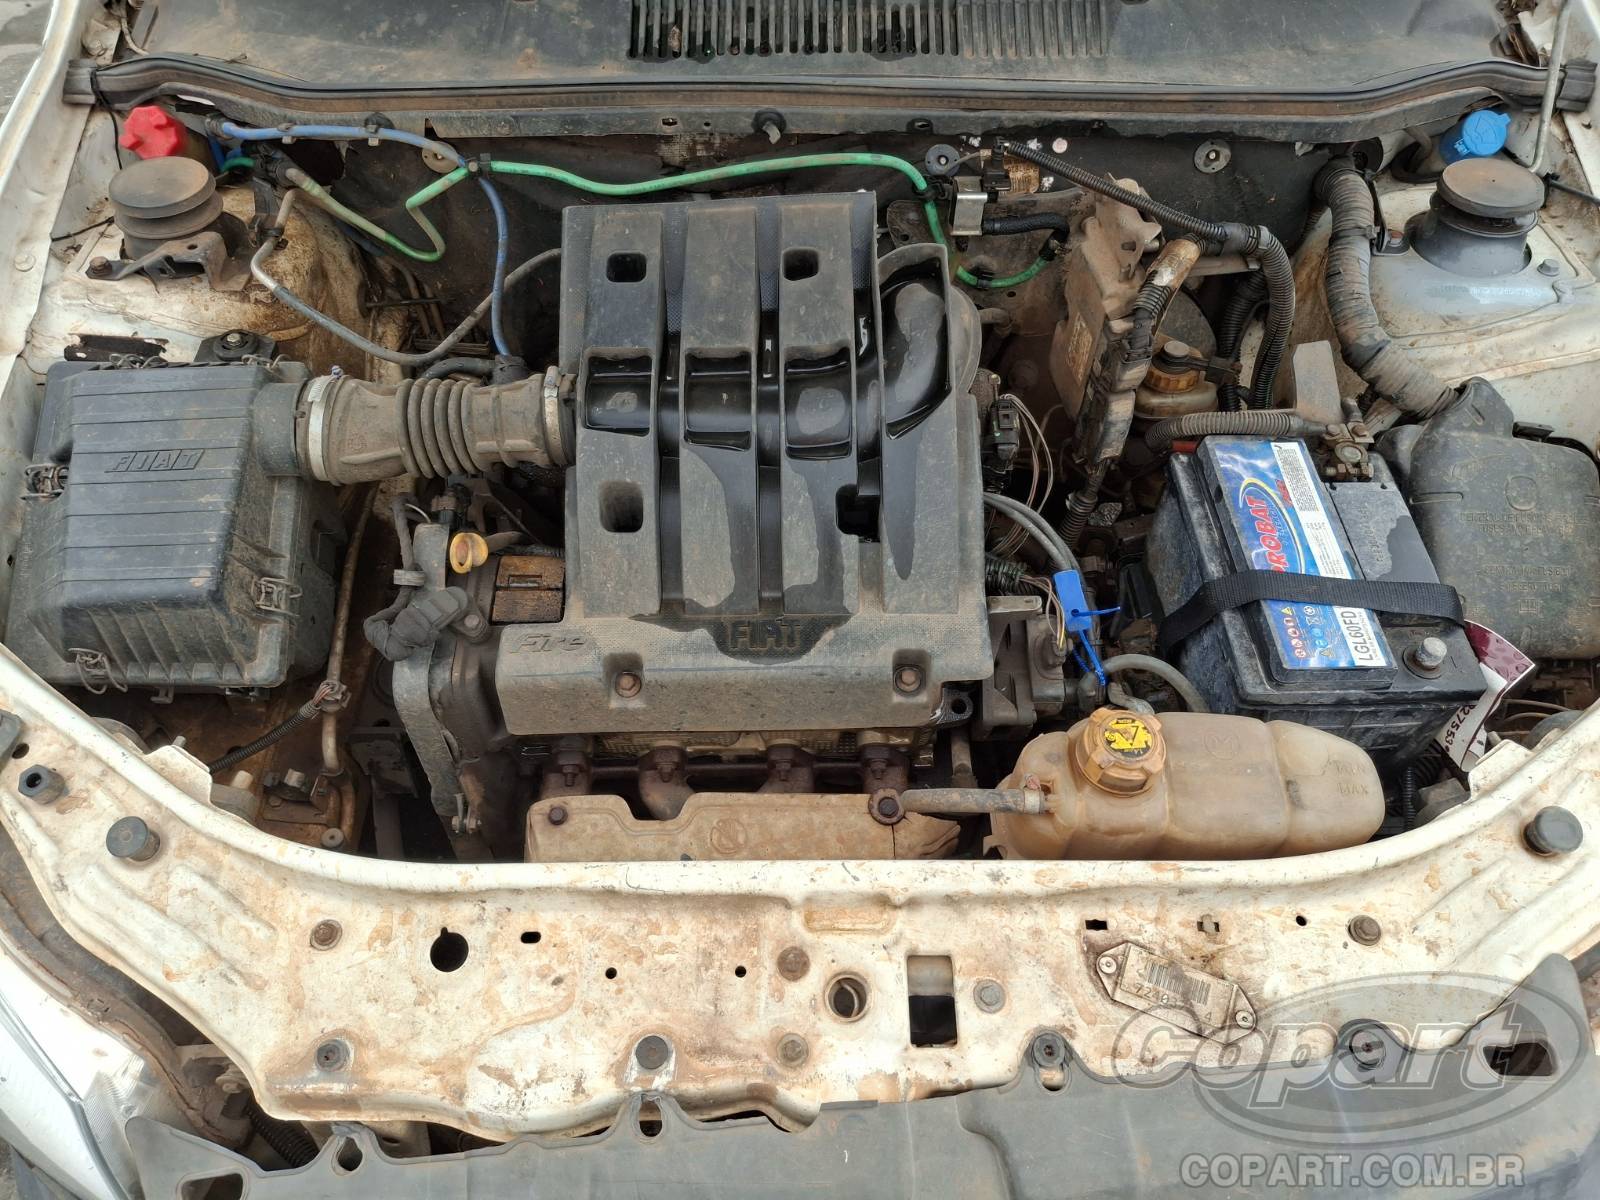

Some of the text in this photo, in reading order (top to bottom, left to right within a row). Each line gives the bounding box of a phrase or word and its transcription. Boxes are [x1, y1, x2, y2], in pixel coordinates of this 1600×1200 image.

[106, 450, 204, 473] FIAT
[728, 622, 802, 651] FIAT
[1341, 610, 1374, 661] LGL60FD
